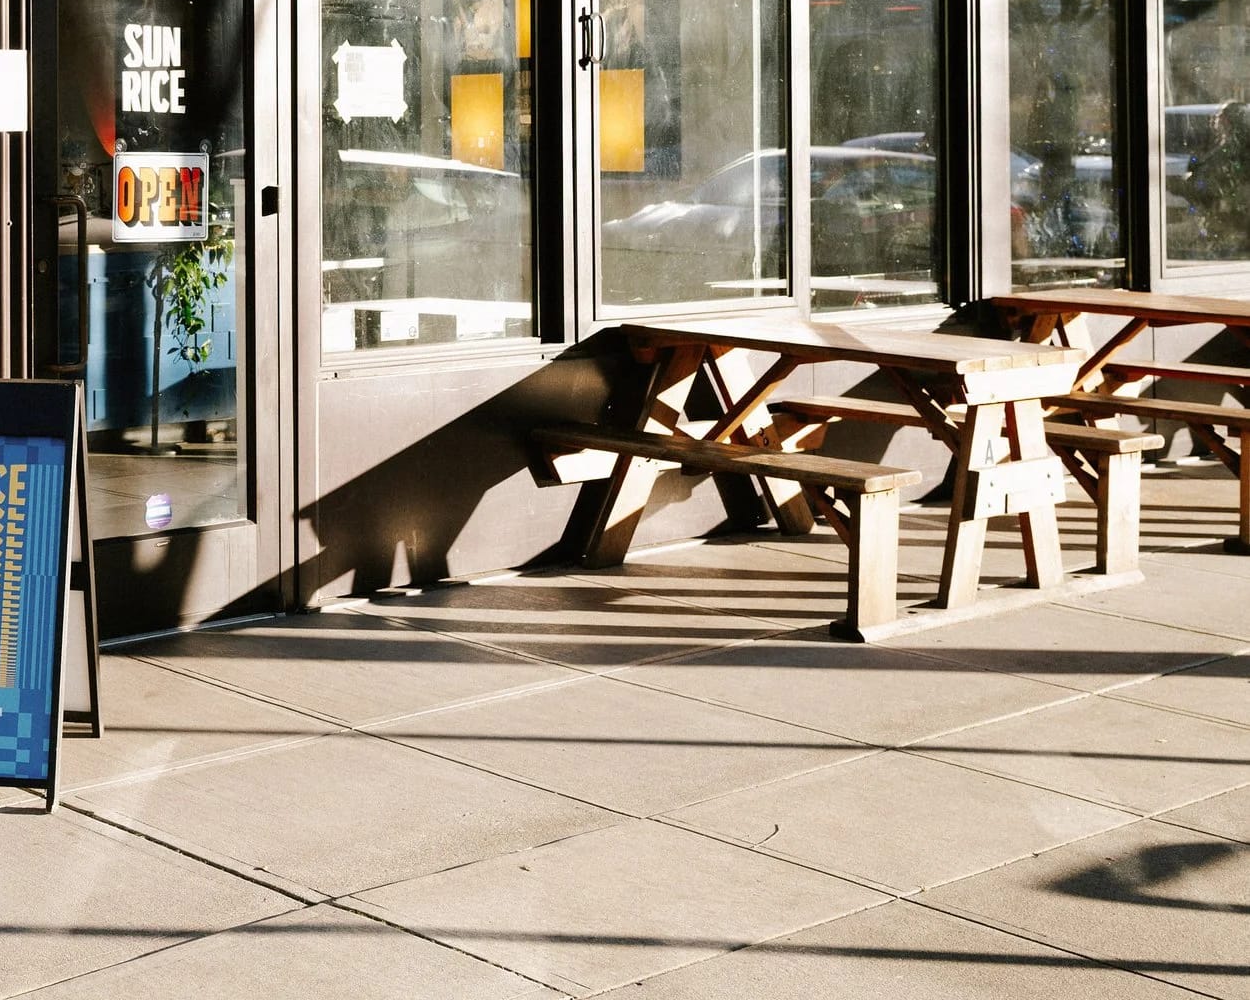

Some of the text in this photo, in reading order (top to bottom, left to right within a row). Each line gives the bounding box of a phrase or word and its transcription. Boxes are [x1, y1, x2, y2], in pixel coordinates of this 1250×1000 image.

[123, 23, 182, 68] SUN
[121, 69, 187, 114] RICE
[117, 165, 205, 227] OPEN
